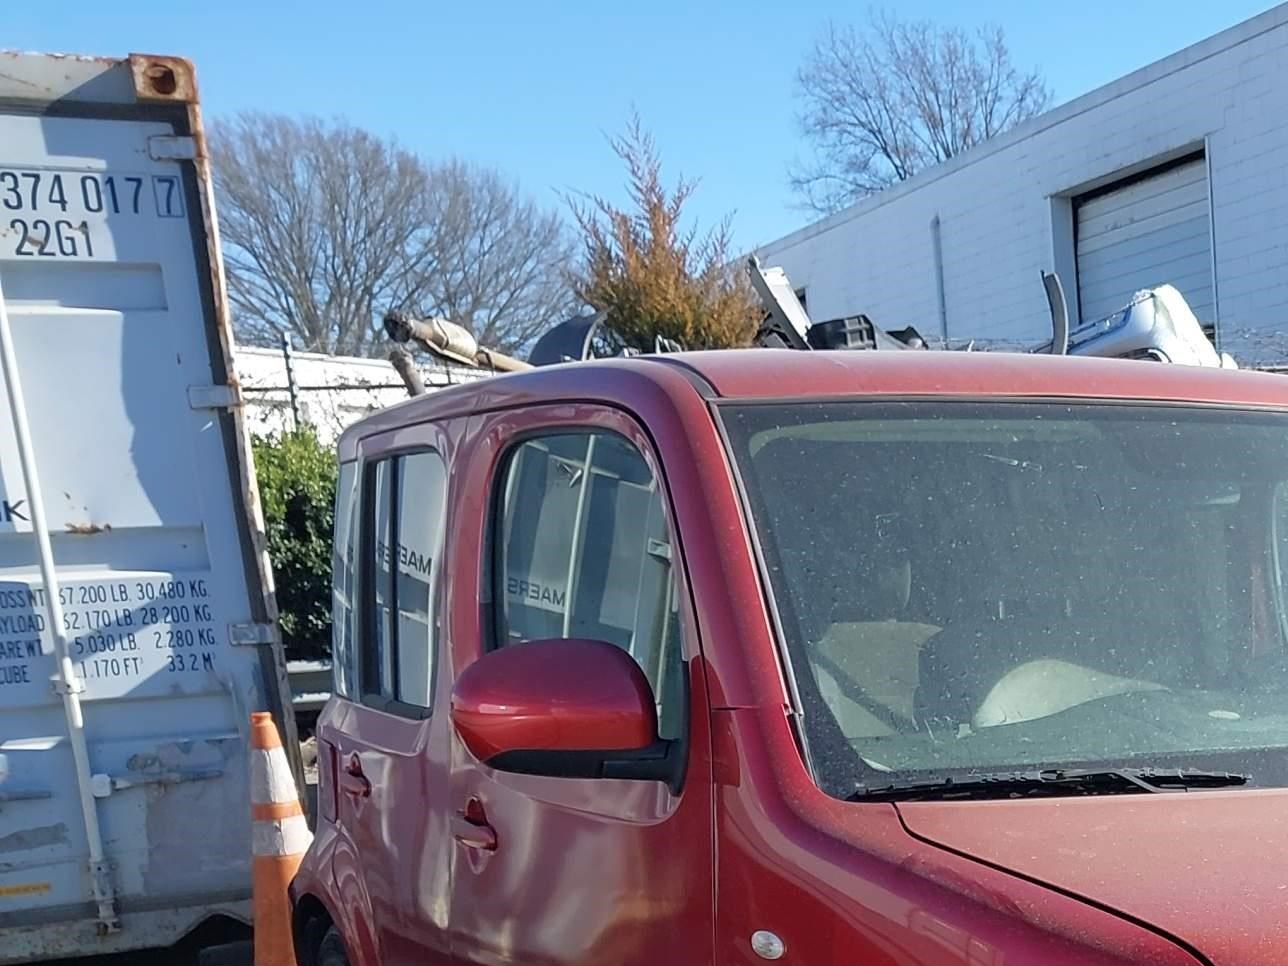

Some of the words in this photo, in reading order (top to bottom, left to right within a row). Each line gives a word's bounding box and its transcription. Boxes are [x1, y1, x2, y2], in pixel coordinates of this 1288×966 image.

[0, 171, 68, 212] 374
[80, 174, 143, 214] 017
[10, 218, 94, 257] 22G1
